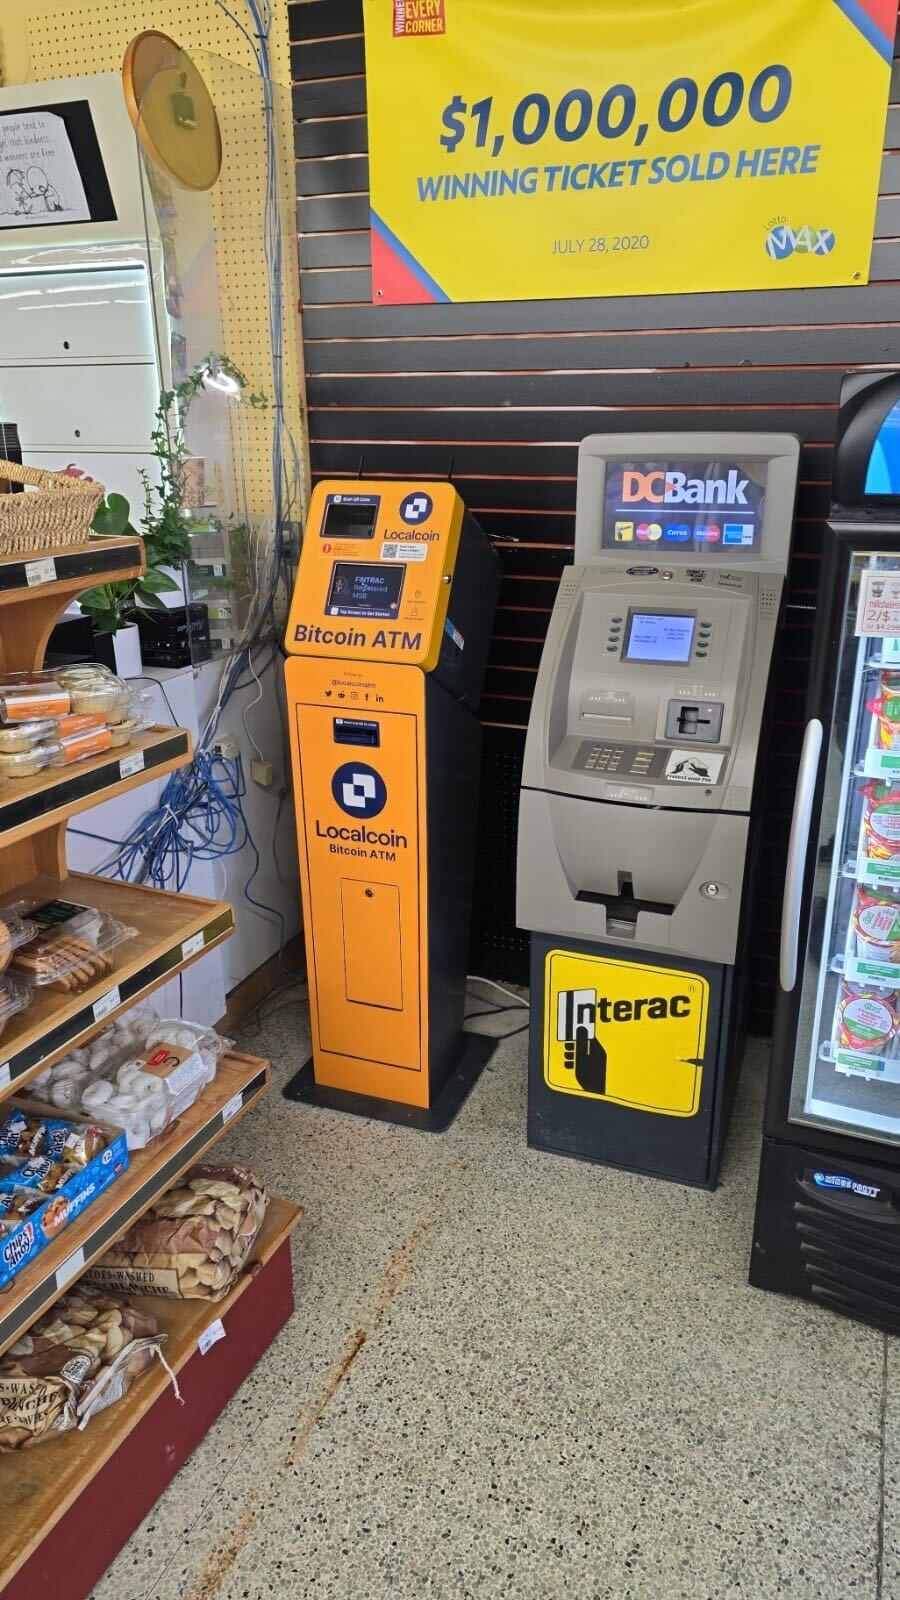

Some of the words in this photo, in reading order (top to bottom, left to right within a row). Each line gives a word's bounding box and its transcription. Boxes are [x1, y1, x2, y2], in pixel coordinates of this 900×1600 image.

[405, 0, 441, 19] EVERY
[405, 18, 444, 33] CORNER
[439, 64, 792, 158] $1,000,000
[416, 166, 539, 202] WINNING
[543, 158, 648, 193] TICKET
[647, 151, 731, 185] SOLD
[735, 144, 821, 179] HERE
[552, 239, 585, 255] JULY
[588, 237, 609, 254] 28,
[612, 234, 650, 251] 2020
[767, 224, 833, 260] MAX
[622, 469, 749, 505] DCBank
[383, 529, 440, 542] Localcoin
[293, 624, 367, 647] Bitcoin
[371, 630, 422, 651] ATM
[315, 819, 408, 848] Localcoin
[329, 843, 368, 858] Bitcoin
[369, 849, 396, 862] ATM
[563, 991, 691, 1030] Interac
[53, 1182, 97, 1227] MUFFINS
[3, 1228, 28, 1261] Chips
[115, 1270, 155, 1283] WASHED
